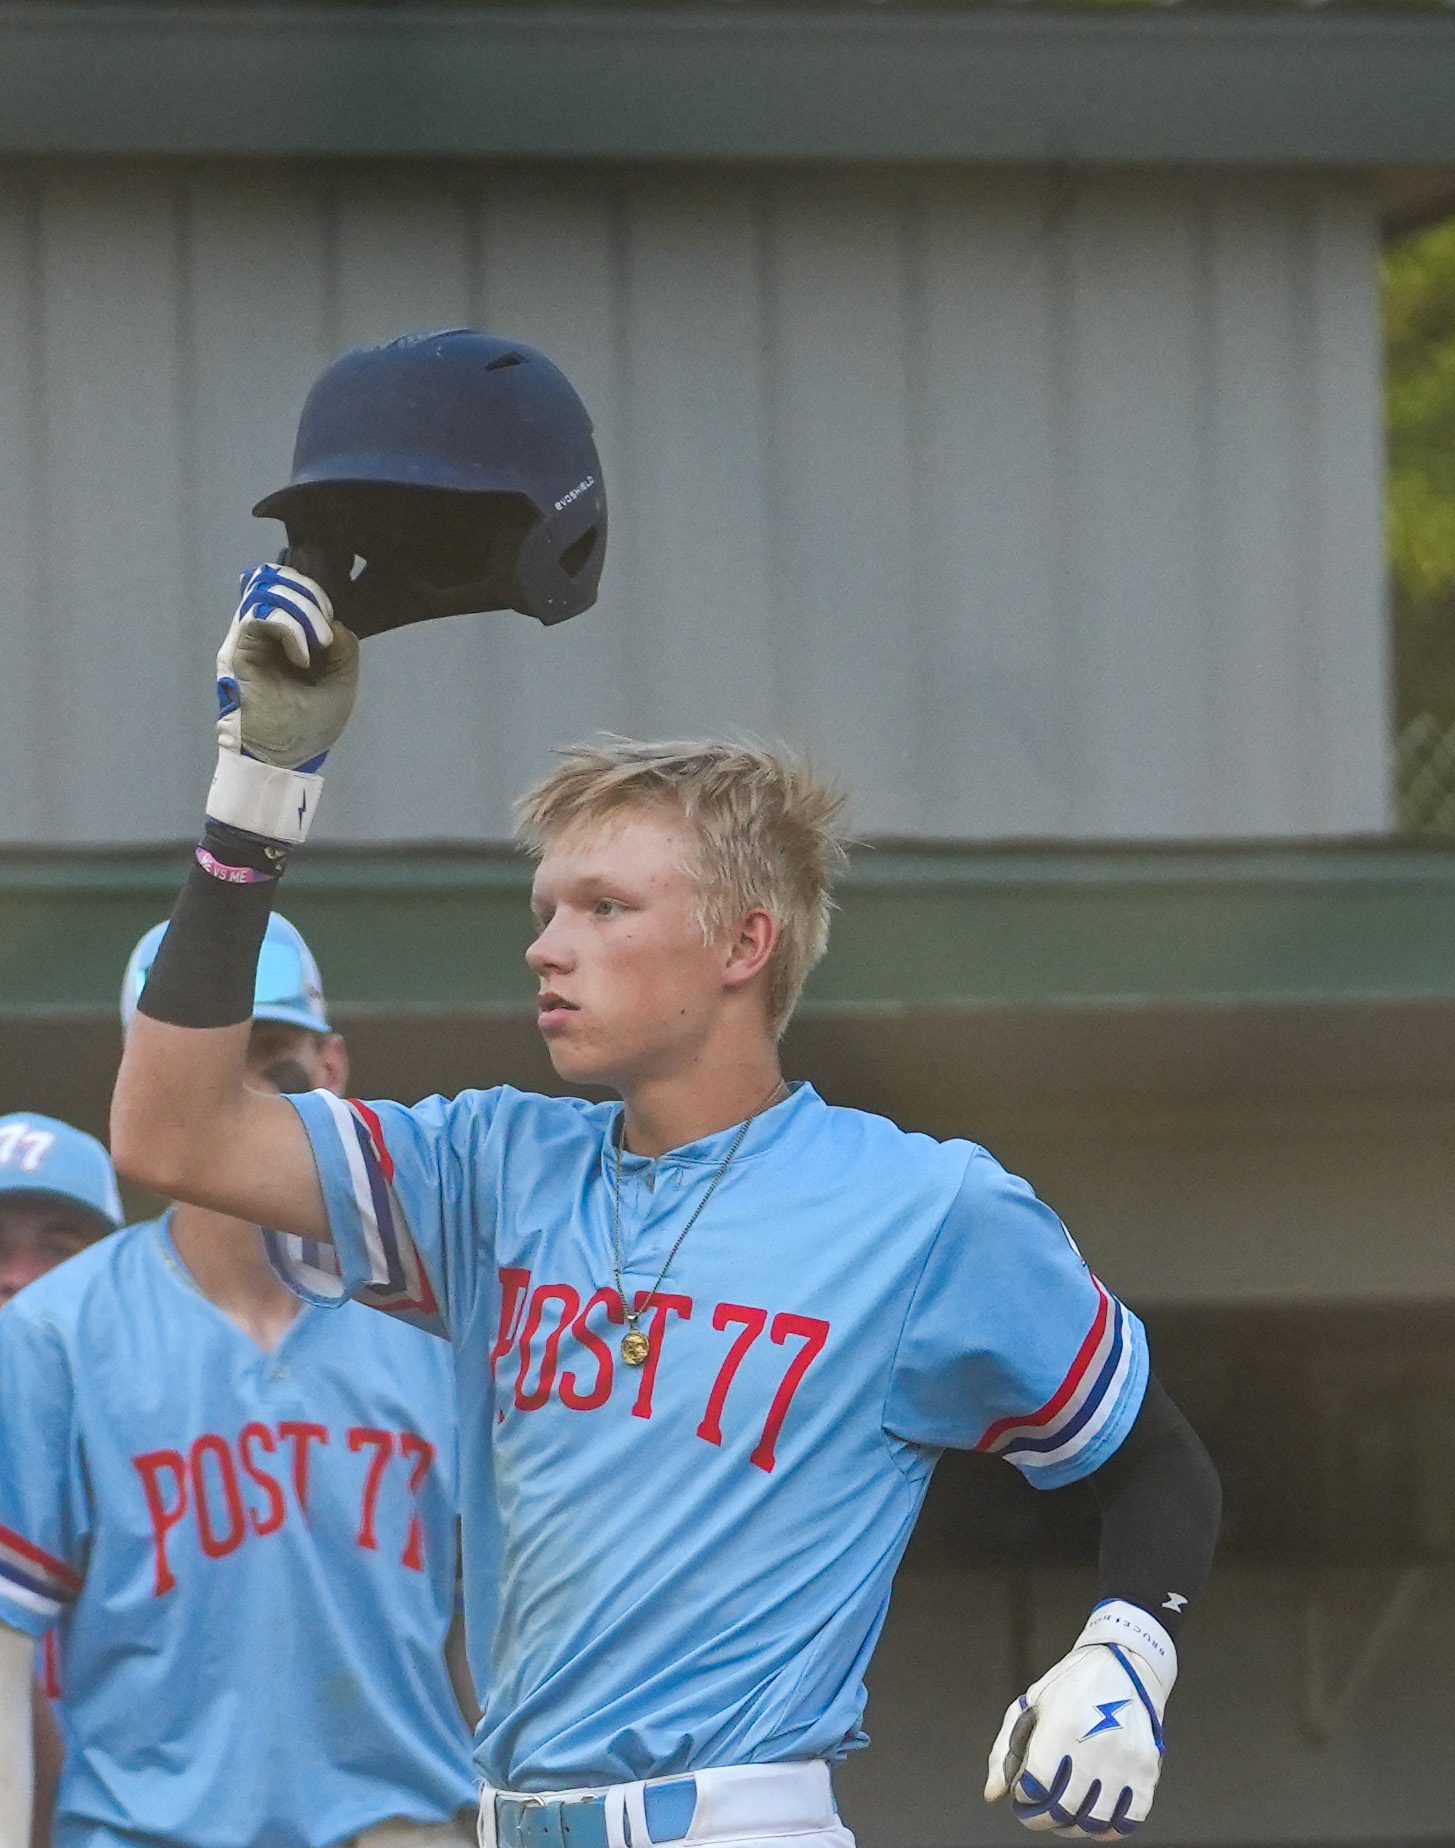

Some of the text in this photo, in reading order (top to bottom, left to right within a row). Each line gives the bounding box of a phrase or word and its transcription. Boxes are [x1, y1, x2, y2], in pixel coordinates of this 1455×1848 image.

[213, 868, 227, 881] VS
[229, 870, 248, 883] ME
[490, 1267, 831, 1473] POST 77
[130, 1421, 438, 1597] POST 77
